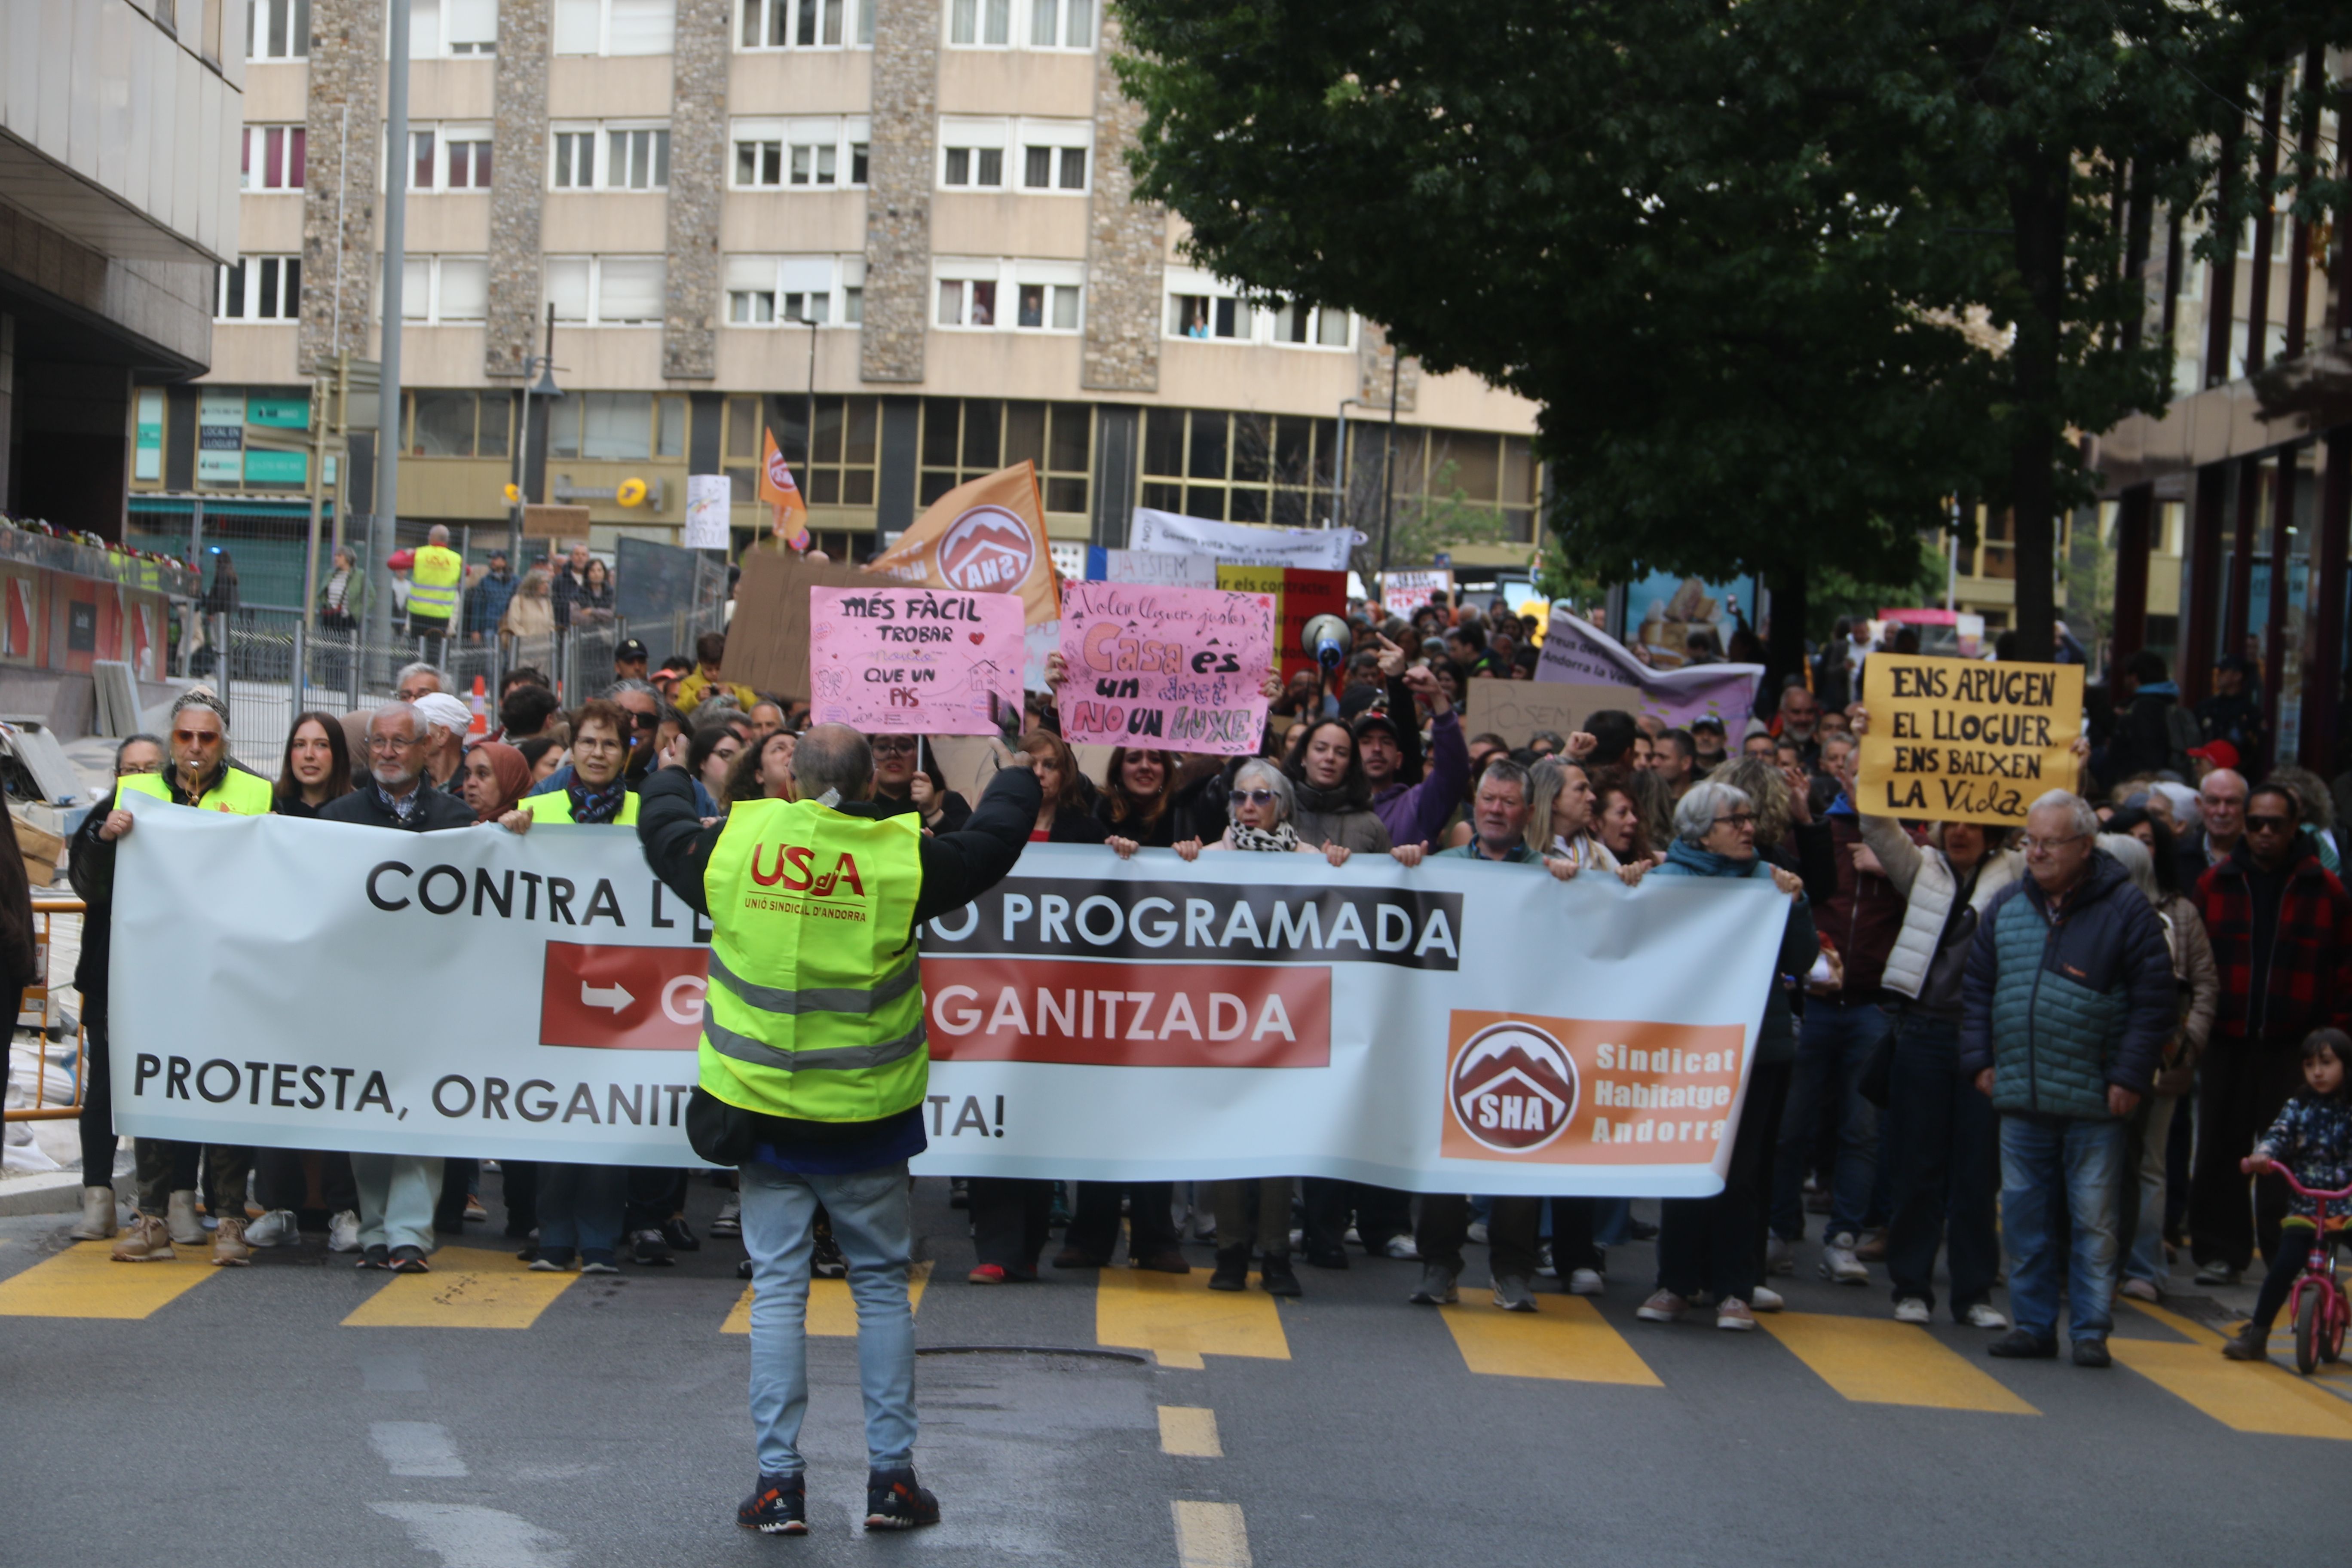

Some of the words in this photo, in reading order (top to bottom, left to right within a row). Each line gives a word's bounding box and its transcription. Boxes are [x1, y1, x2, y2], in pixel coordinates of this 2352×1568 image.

[202, 426, 226, 437] LOCAL
[228, 427, 239, 438] EN
[203, 438, 238, 449] LLOGUER
[1140, 554, 1187, 579] ESTEM
[1234, 577, 1256, 592] els
[876, 625, 953, 643] TROBAR
[1083, 622, 1182, 675] Casa
[864, 667, 905, 683] QUE
[911, 668, 935, 683] UN
[1542, 650, 1591, 674] Andorra
[1593, 665, 1606, 678] la
[1890, 666, 1948, 698] ENS
[1953, 668, 2057, 707] APUGEN
[1072, 700, 1124, 733] NO
[1127, 707, 1163, 738] UN
[1169, 706, 1251, 743] LUXE
[1893, 712, 1921, 738] EL
[1893, 746, 1939, 773] ENS
[1947, 749, 2042, 779] BAIXEN
[1886, 779, 1926, 808] LA
[1939, 778, 2028, 816] Vida
[365, 860, 626, 927] CONTRA
[1002, 892, 1458, 959] PROGRAMADA
[745, 897, 767, 910] UNIÓ
[769, 900, 810, 916] SINDICAL
[812, 906, 867, 923] D'ANDORRA
[922, 984, 1296, 1042] GANITZADA
[1596, 1042, 1735, 1074] Sindicat
[134, 1052, 408, 1121] PROTESTA,
[927, 1095, 1004, 1138] TA!
[1594, 1079, 1731, 1110] Habitatge
[1478, 1093, 1545, 1131] SHA
[1591, 1117, 1727, 1144] Andorra
